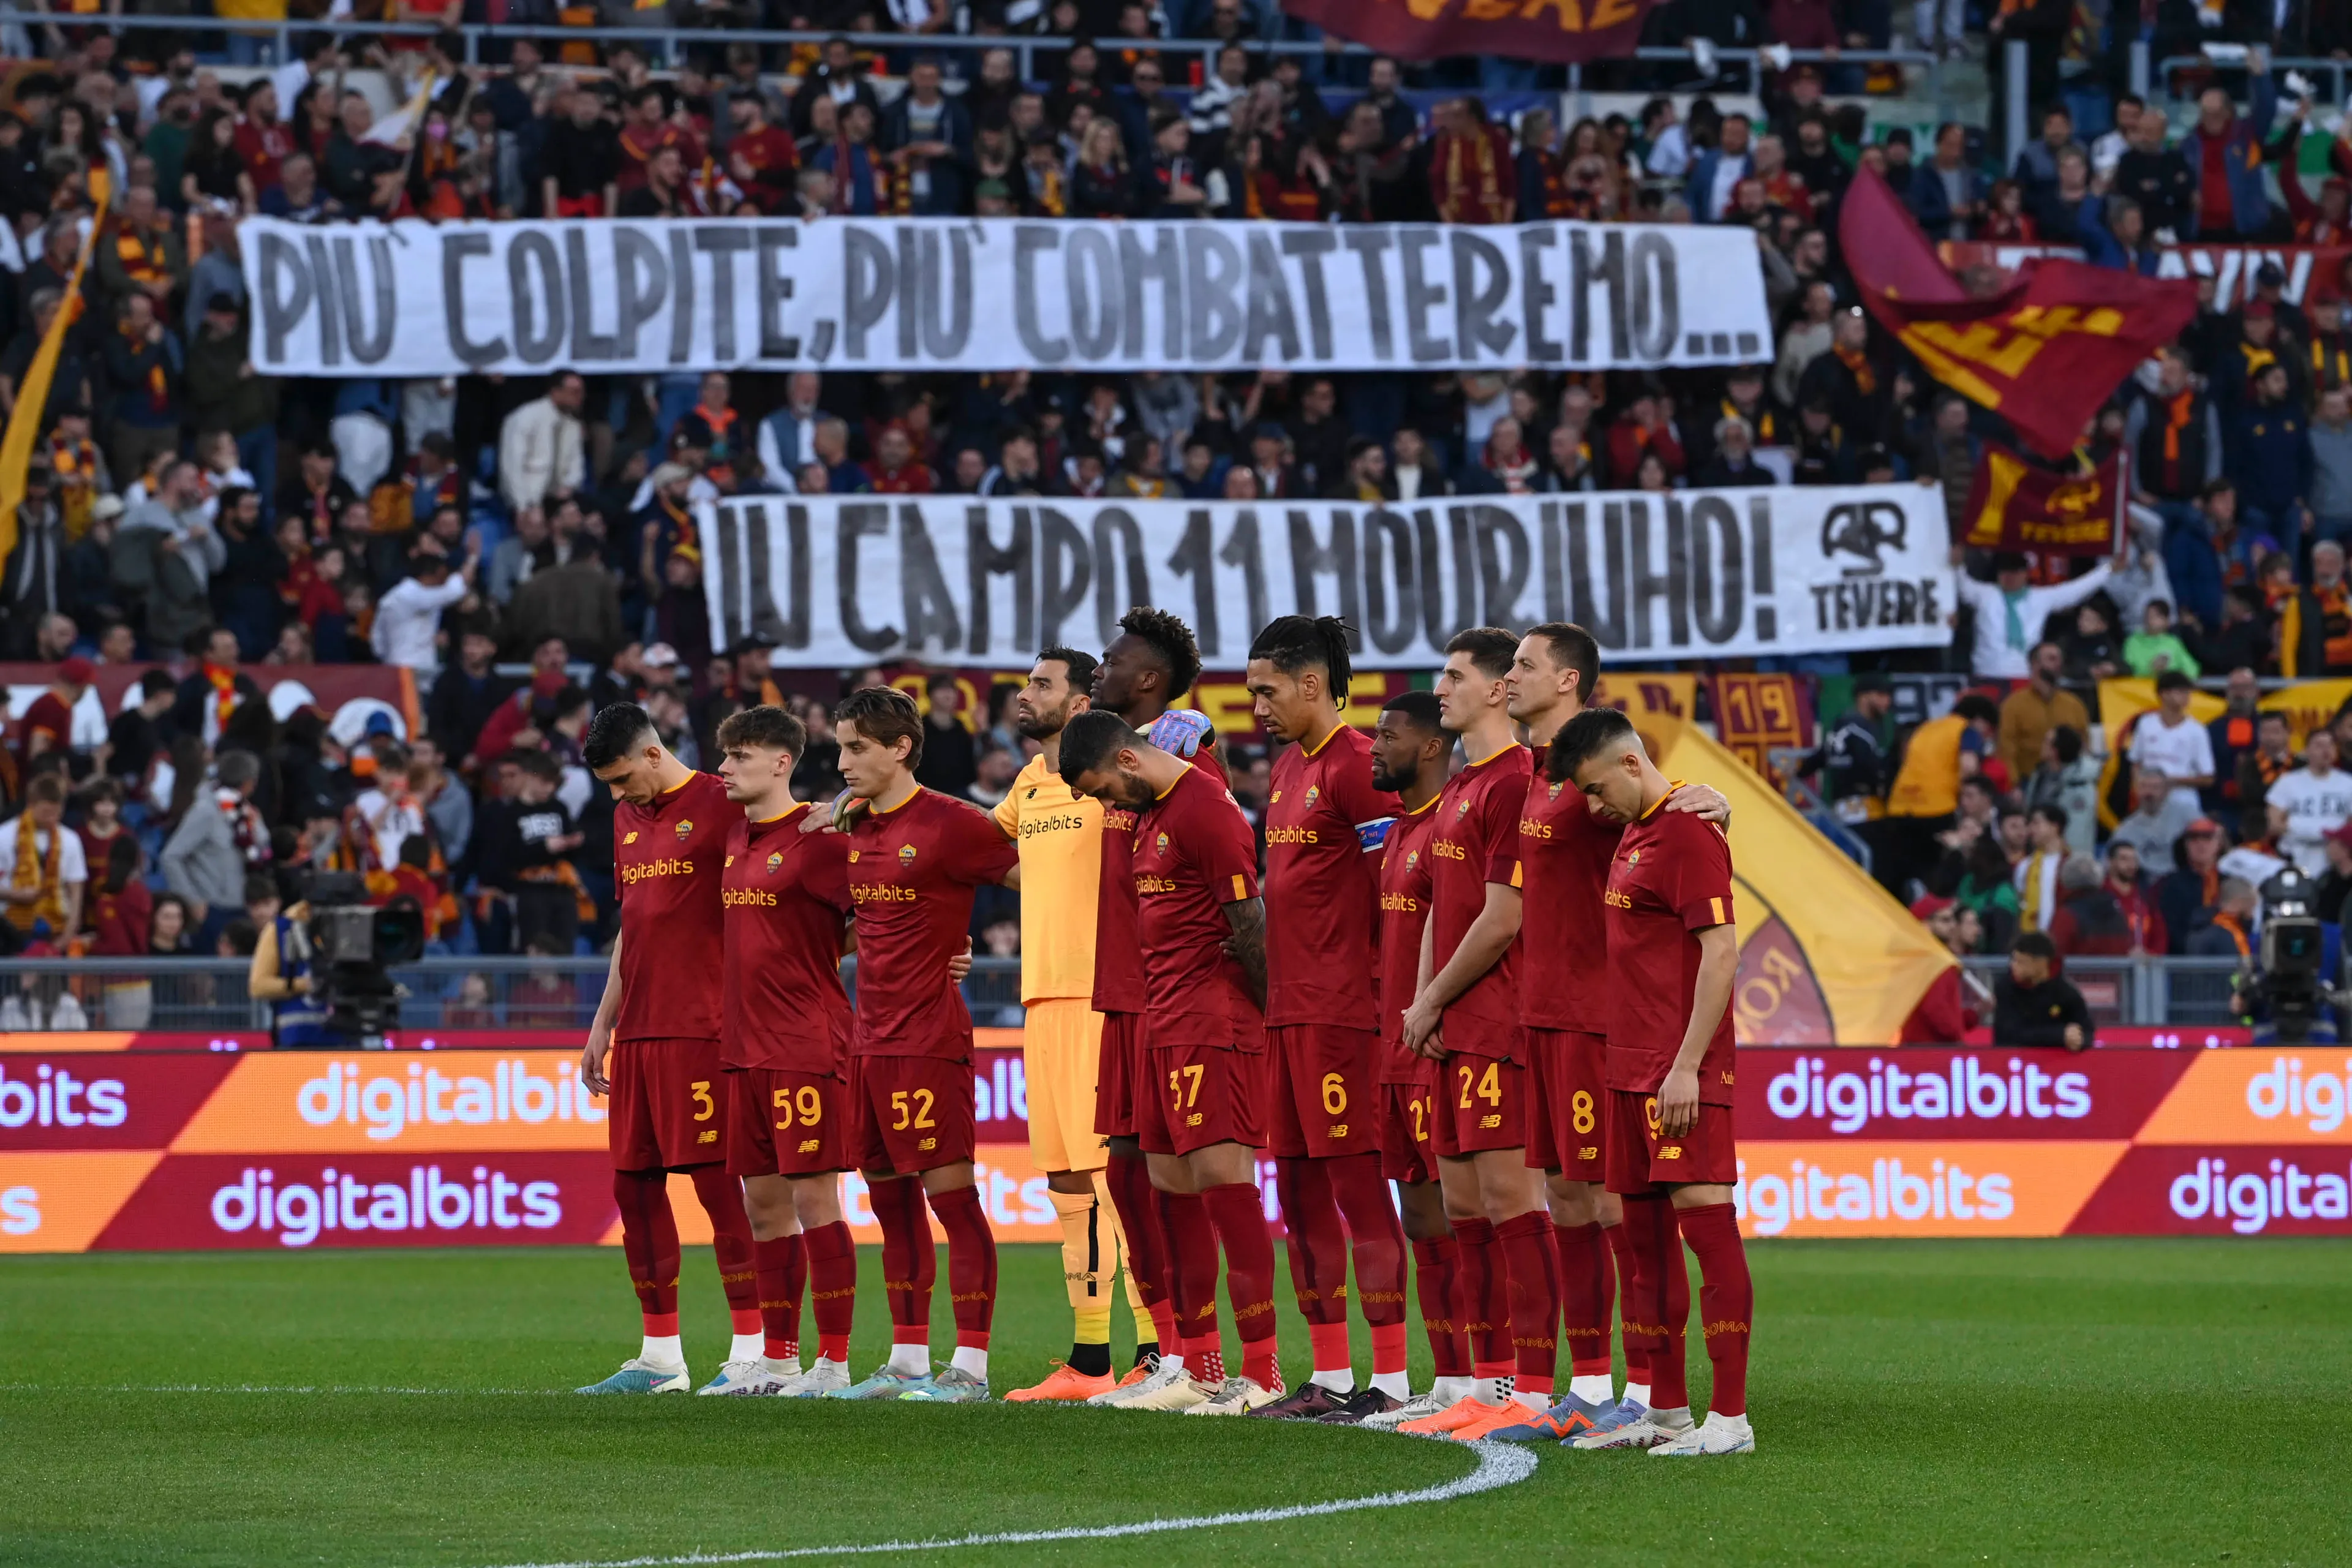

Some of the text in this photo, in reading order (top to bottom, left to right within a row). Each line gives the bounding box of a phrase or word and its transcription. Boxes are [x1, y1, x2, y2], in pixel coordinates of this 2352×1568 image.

[837, 503, 1153, 655] CAMPO
[1167, 508, 1272, 656] 11
[1811, 579, 1940, 631] TEVERE
[1730, 682, 1789, 729] 19
[1019, 814, 1083, 839] digitalbits
[1265, 825, 1318, 848] igitalbits
[622, 858, 694, 884] digitalbits
[722, 887, 777, 909] igitalbits
[296, 1060, 611, 1140] digitalbit
[691, 1080, 714, 1121] 3
[774, 1085, 821, 1130] 59
[1170, 1064, 1204, 1112] 37
[1322, 1072, 1347, 1115] 6
[1458, 1063, 1502, 1109] 24
[1766, 1056, 2092, 1134] digitalbits
[892, 1088, 936, 1131] 52
[1572, 1090, 1595, 1134] 8
[1645, 1097, 1665, 1140] 9
[211, 1166, 562, 1246] digitalbits
[1733, 1158, 2015, 1237] igitalbits
[2169, 1158, 2352, 1235] digita
[951, 1291, 989, 1302] OMA
[1565, 1328, 1600, 1336] OMA
